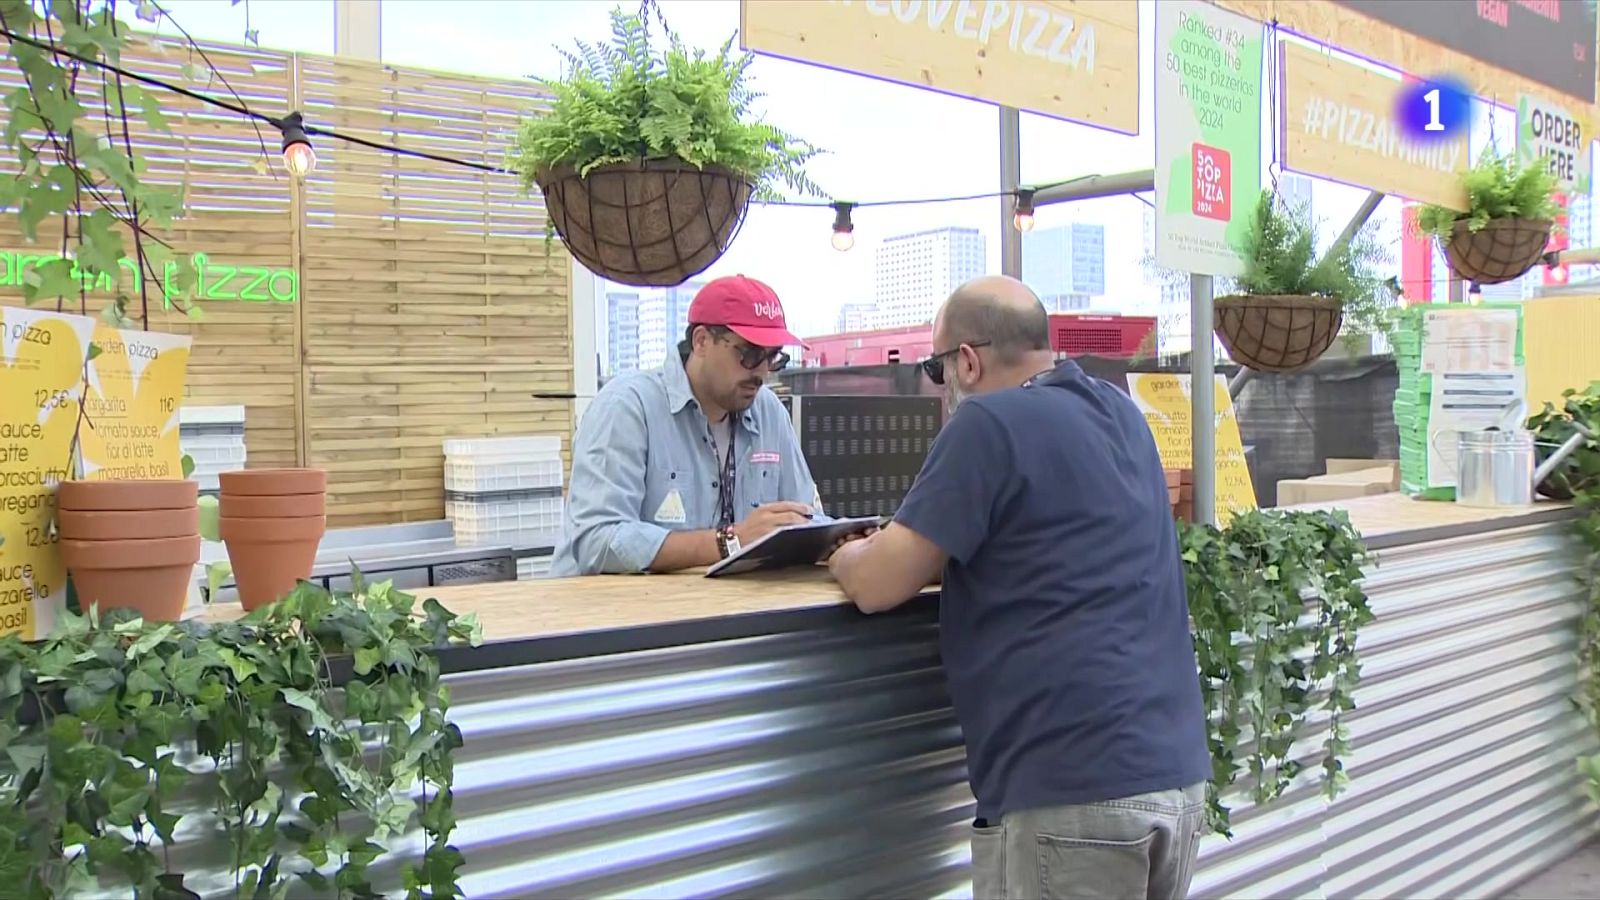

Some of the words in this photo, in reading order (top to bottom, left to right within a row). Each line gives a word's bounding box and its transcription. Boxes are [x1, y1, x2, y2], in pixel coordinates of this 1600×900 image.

[1179, 10, 1222, 42] Ranked
[1225, 28, 1246, 50] #34
[1181, 39, 1221, 67] among
[1224, 49, 1241, 71] the
[1166, 52, 1180, 73] 50
[1183, 59, 1207, 81] best
[1210, 69, 1254, 97] pizzerias
[1179, 78, 1189, 98] in
[1192, 83, 1210, 104] the
[1213, 93, 1242, 114] world
[1199, 107, 1224, 131] 2024
[1532, 108, 1581, 150] ORDER
[1196, 163, 1221, 183] TOP
[1197, 201, 1213, 214] 2024
[11, 321, 51, 345] pizza
[128, 340, 159, 361] pizza
[34, 388, 70, 412] 12,5€
[86, 396, 126, 416] argarita
[159, 396, 175, 414] 11€
[0, 423, 45, 441] auce,
[95, 421, 129, 440] tomato
[130, 425, 161, 440] sauce,
[133, 442, 154, 458] latte
[149, 460, 170, 478] basil
[0, 494, 56, 514] regano
